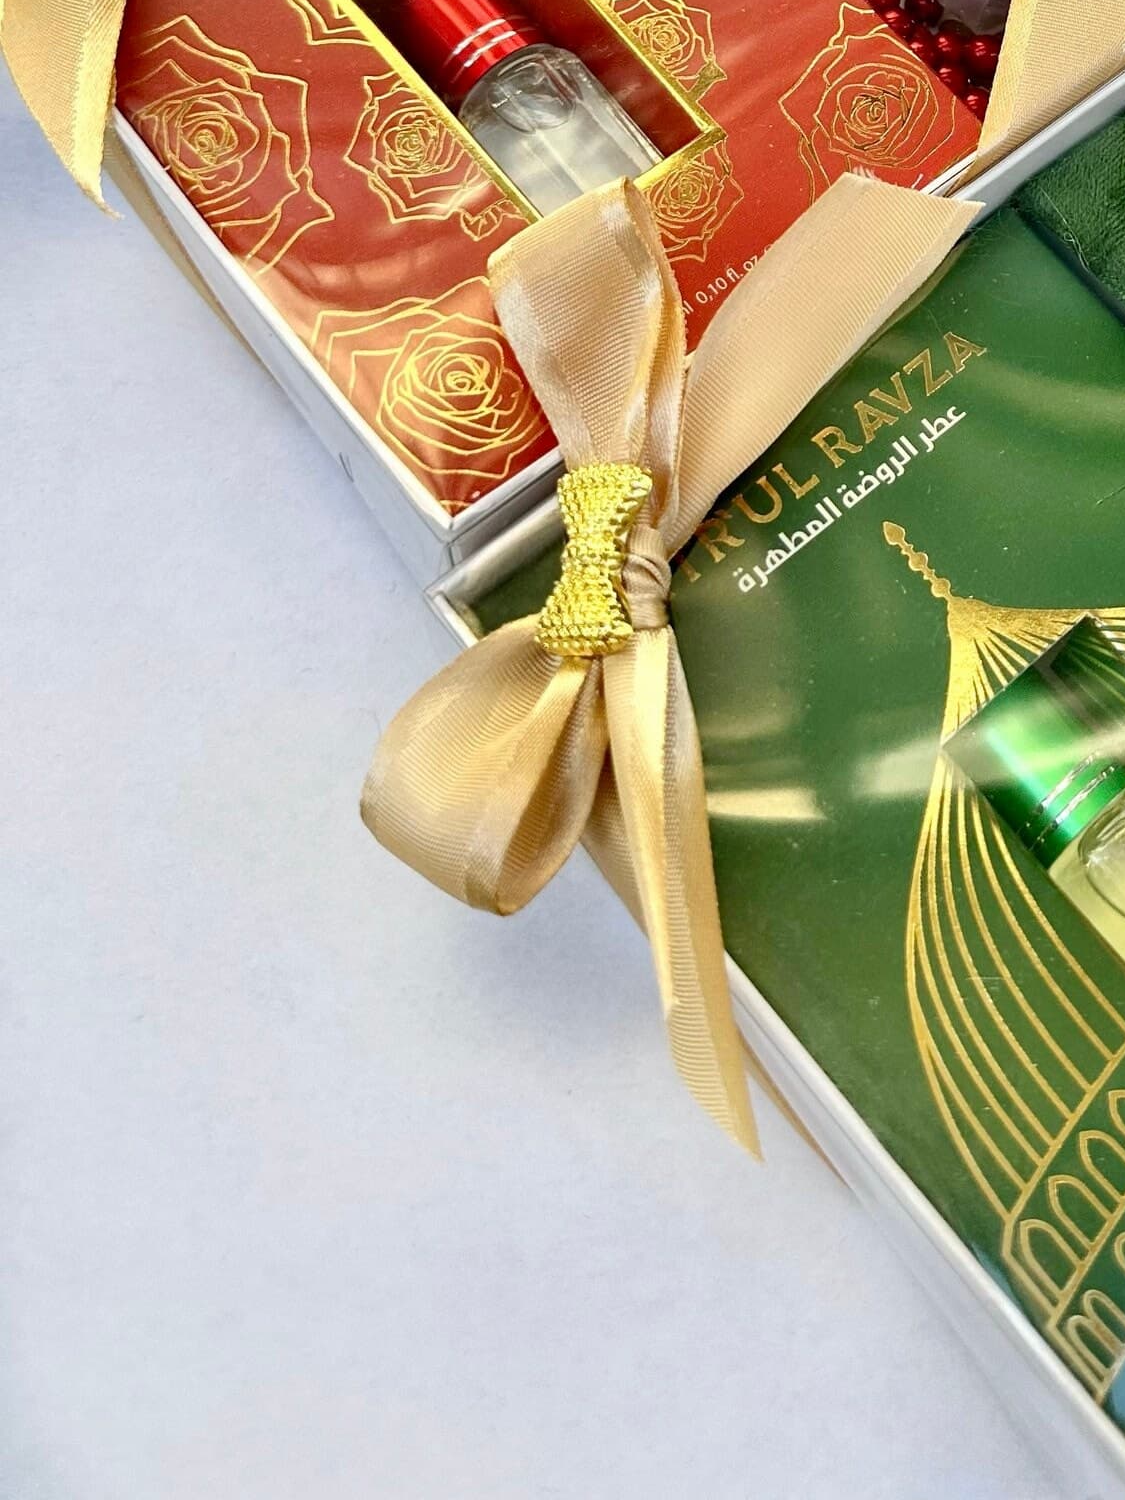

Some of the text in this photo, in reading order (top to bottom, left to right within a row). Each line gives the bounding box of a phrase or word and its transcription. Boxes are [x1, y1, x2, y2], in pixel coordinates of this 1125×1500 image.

[695, 276, 728, 304] 0,10
[676, 331, 988, 583] RUL RAVZA
[732, 405, 967, 593] عطر الروضة المطهرة
